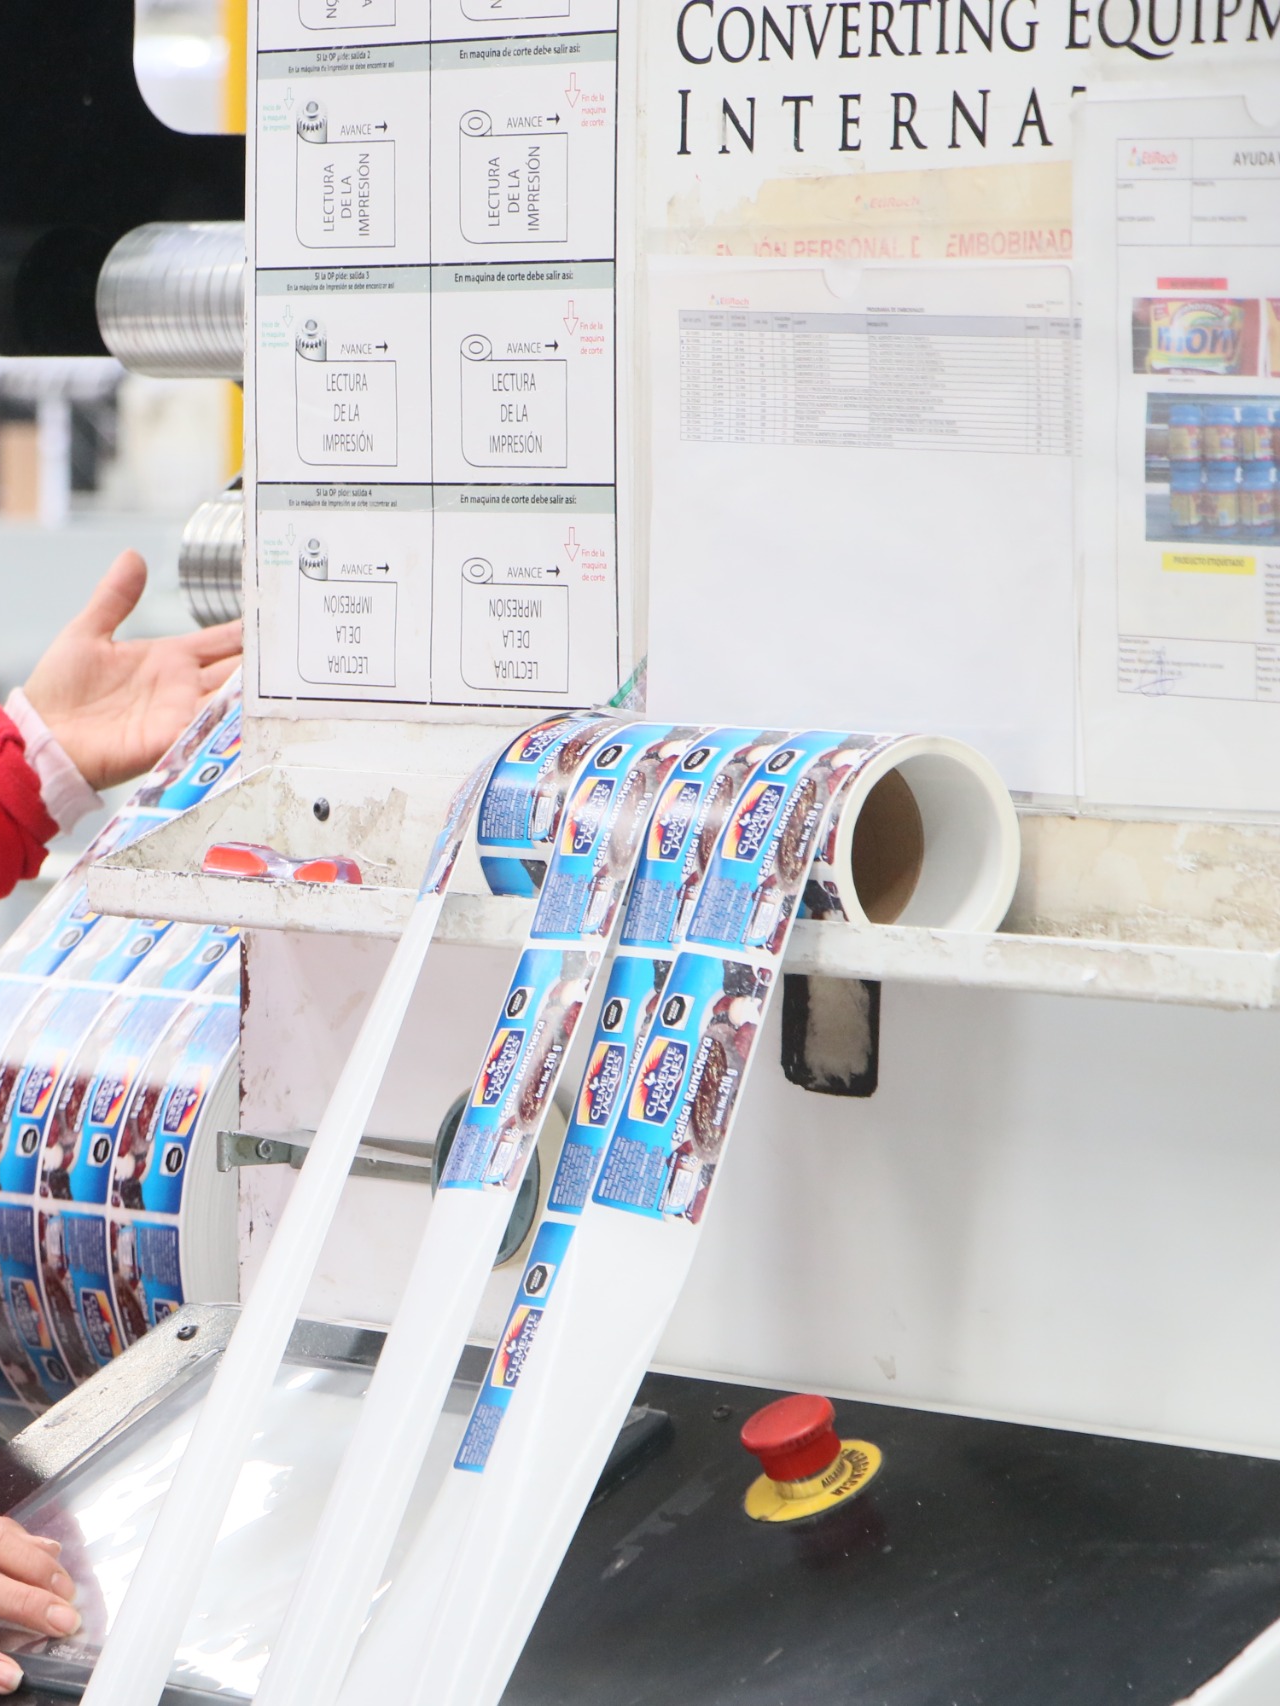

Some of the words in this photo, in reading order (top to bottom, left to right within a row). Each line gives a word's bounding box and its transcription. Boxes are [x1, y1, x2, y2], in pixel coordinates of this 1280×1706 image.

[677, 0, 1039, 64] CONVERTING
[351, 51, 366, 60] salida
[367, 50, 370, 59] 2
[460, 50, 468, 59] En
[470, 48, 500, 60] maquina
[502, 47, 512, 56] de
[513, 46, 532, 56] corte
[533, 45, 552, 55] debe
[554, 44, 568, 54] salir
[582, 94, 590, 102] Fin
[591, 94, 598, 102] de
[599, 93, 604, 101] la
[582, 106, 606, 115] maquina
[341, 124, 371, 135] AVANCE
[507, 116, 542, 128] AVANCE
[677, 87, 1086, 154] INTERNA
[1233, 152, 1276, 166] AYUDA
[341, 176, 351, 194] LA
[508, 169, 519, 188] LA
[323, 164, 334, 231] LECTURA
[358, 154, 369, 236] IMPRESIÓN
[488, 157, 500, 226] LECTURA
[526, 147, 540, 230] IMPRESIÓN
[341, 200, 351, 218] DE
[508, 193, 519, 213] DE
[945, 228, 1072, 258] EMBOBINAD
[327, 272, 334, 280] OP
[349, 271, 364, 279] salida
[366, 271, 370, 279] 3
[454, 273, 463, 282] En
[464, 272, 495, 284] maquina
[496, 271, 505, 281] de
[507, 272, 525, 281] corte
[526, 271, 544, 281] debe
[546, 270, 560, 280] salir
[580, 322, 588, 330] Fin
[507, 342, 541, 353] AVANCE
[580, 335, 604, 343] maquina
[341, 344, 372, 354] AVANCE
[327, 373, 367, 391] LECTURA
[492, 373, 536, 391] LECTURA
[334, 404, 346, 421] DE
[349, 404, 359, 421] LA
[501, 404, 513, 422] DE
[516, 404, 528, 422] LA
[323, 431, 373, 452] IMPRESIÓN
[490, 432, 542, 453] IMPRESIÓN
[329, 488, 336, 496] OP
[460, 494, 468, 504] En
[470, 494, 500, 506] maquina
[501, 494, 510, 504] de
[511, 495, 529, 504] corte
[531, 494, 548, 504] debe
[550, 495, 564, 504] salir
[591, 549, 599, 557] de
[600, 549, 605, 557] la
[341, 564, 372, 575] AVANCE
[508, 567, 542, 578] AVANCE
[582, 562, 607, 571] maquina
[590, 574, 605, 582] corte
[336, 626, 346, 642] LA
[349, 626, 360, 644] DE
[503, 630, 514, 647] LA
[517, 630, 529, 648] DE
[328, 656, 368, 674] LECTURA
[494, 661, 537, 679] LECTURA
[594, 833, 612, 868] Salsa
[607, 770, 639, 829] Ranchera
[682, 838, 700, 875] Salsa
[694, 775, 726, 835] Ranchera
[738, 789, 773, 855] CLEMENTE
[748, 794, 780, 851] JACQUES
[759, 840, 780, 878] Salsa
[773, 778, 810, 838] Ranchera
[804, 810, 818, 828] 210
[484, 1035, 515, 1100] CLEMENTE
[493, 1039, 521, 1095] JACQUES
[501, 1083, 519, 1119] Salsa
[517, 1020, 545, 1080] Ranchera
[544, 1053, 556, 1069] 210
[590, 1050, 616, 1120] CLEMENTE
[600, 1056, 622, 1115] JACQUES
[646, 1046, 676, 1117] CLEMENTE
[657, 1052, 685, 1114] JACQUES
[672, 1105, 692, 1143] Salsa
[684, 1036, 713, 1102] Ranchera
[719, 1076, 734, 1095] 210
[727, 1068, 738, 1076] g
[506, 1313, 537, 1382] CLEMENTE
